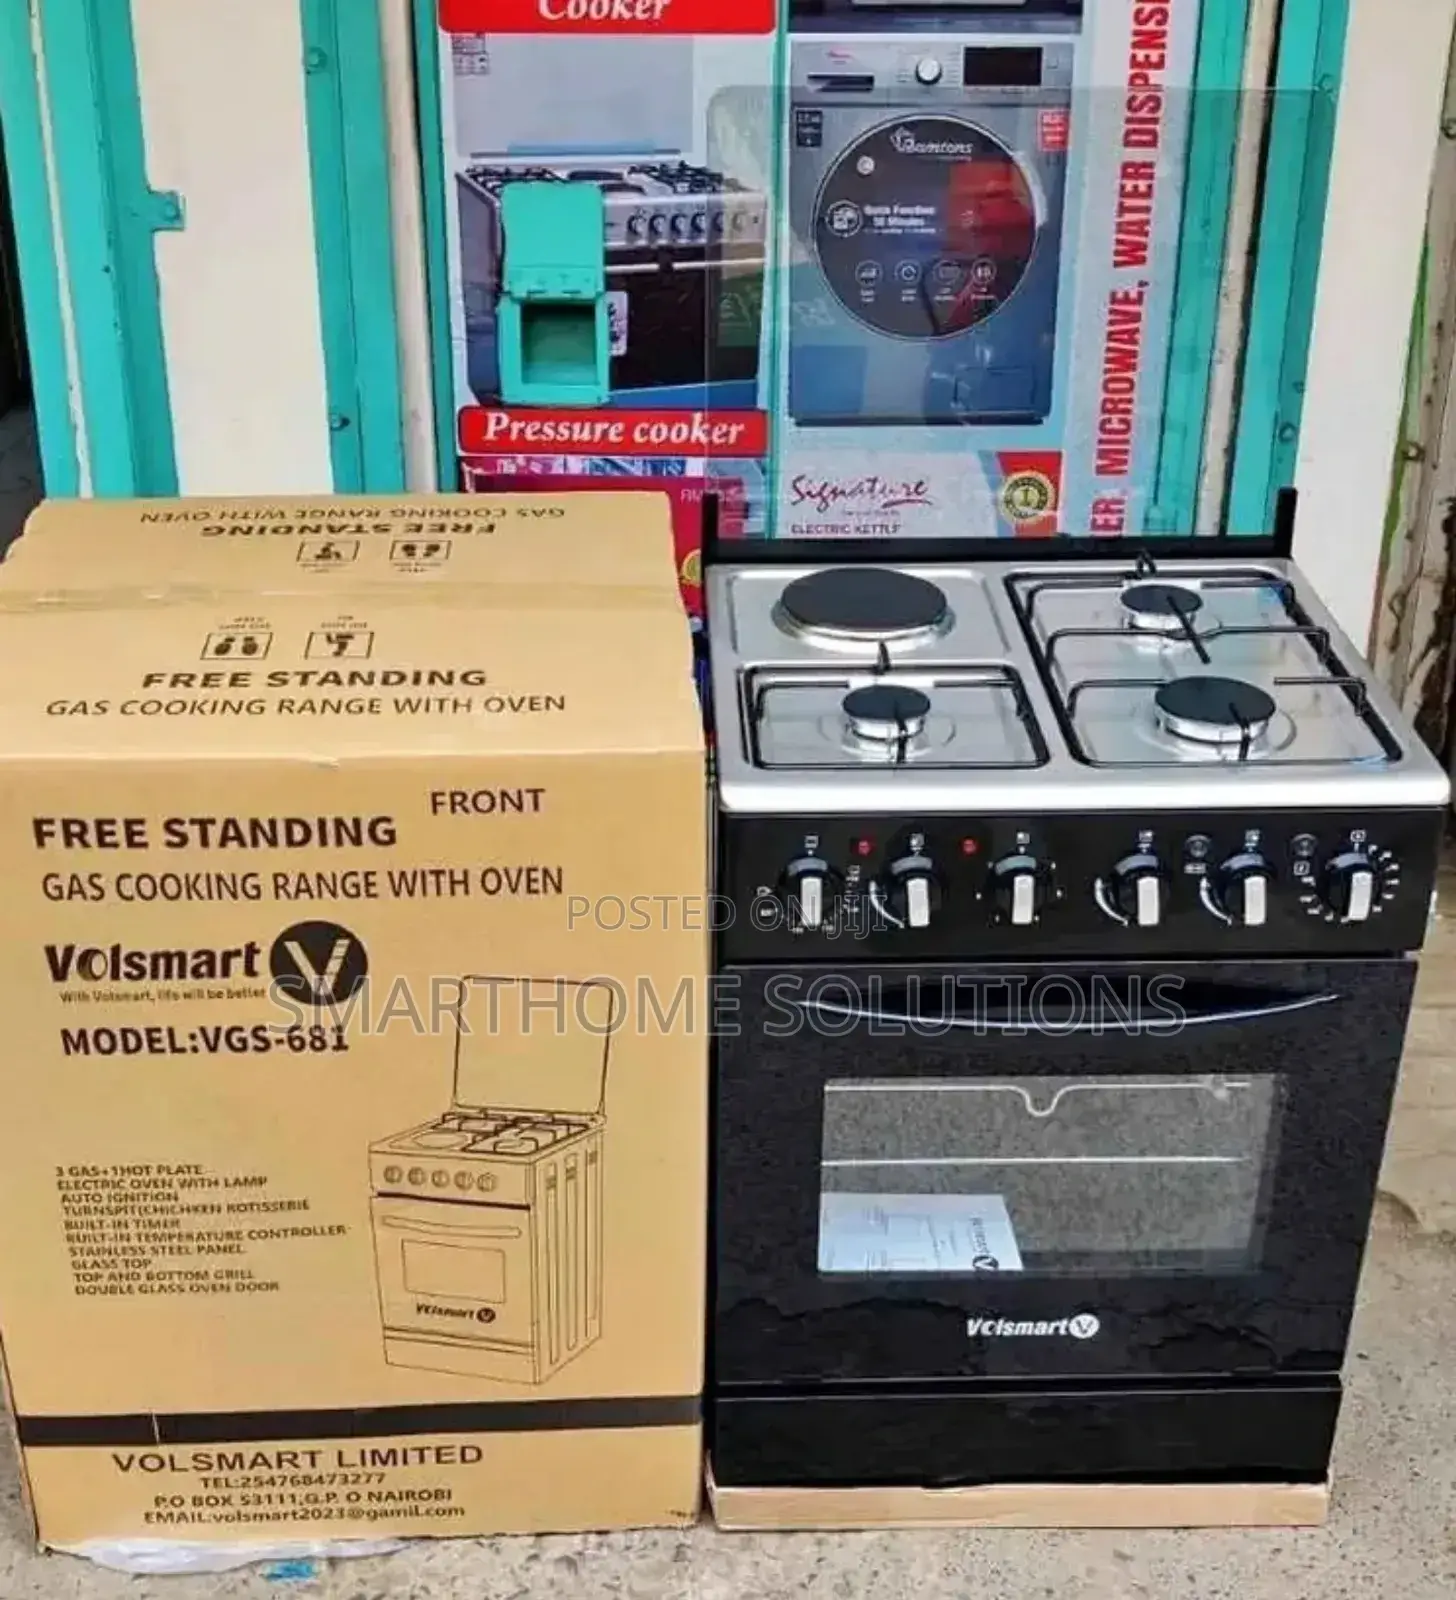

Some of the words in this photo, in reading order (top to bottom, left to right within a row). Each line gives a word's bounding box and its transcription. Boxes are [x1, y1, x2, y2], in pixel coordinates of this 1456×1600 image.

[539, 0, 672, 20] Cooker
[1123, 0, 1170, 149] DISPENS
[1113, 161, 1156, 268] WATER
[1095, 280, 1149, 475] MICROWAVE,
[483, 411, 624, 443] Pressure
[632, 411, 745, 444] cooker
[790, 475, 930, 513] Signature
[140, 511, 211, 523] OVEN
[219, 510, 286, 521] WITH
[295, 508, 381, 519] RANGE
[390, 507, 507, 519] COOKING
[516, 507, 565, 518] GAS
[202, 523, 392, 537] STANDING
[404, 522, 496, 535] FREE
[791, 524, 850, 534] ELECTRIC
[142, 670, 252, 688] FREE
[266, 669, 487, 687] STANDING
[46, 699, 110, 716] GAS
[119, 699, 266, 716] COOKING
[277, 698, 382, 715] RANGE
[393, 696, 473, 714] WITH
[483, 695, 566, 712] OVEN
[431, 788, 545, 816] FRONT
[33, 817, 149, 849] FREE
[164, 815, 398, 848] STANDING
[42, 872, 105, 902] GAS
[116, 871, 262, 902] COOKING
[273, 869, 378, 900] RANGE
[388, 868, 470, 898] WITH
[480, 867, 563, 896] OVEN
[45, 941, 262, 983] Volsmart
[60, 990, 89, 1003] With
[182, 988, 204, 1000] will
[206, 988, 224, 999] be
[226, 987, 267, 999] better
[60, 1025, 350, 1056] MODEL:VGS-681
[55, 1166, 64, 1177] 3
[157, 1164, 203, 1176] PLATE
[56, 1179, 126, 1191] ELECTRIC
[130, 1178, 173, 1190] OVEN
[177, 1177, 220, 1190] WITH
[224, 1176, 268, 1189] LAMP
[61, 1192, 103, 1205] AUTO
[107, 1190, 180, 1204] IGNITION
[226, 1199, 310, 1213] ROTISSERIE
[64, 1217, 129, 1231] BUILT-IN
[133, 1217, 181, 1230] TIMER
[65, 1231, 131, 1244] BUILT-IN
[135, 1229, 244, 1244] TEMPERATURE
[247, 1224, 347, 1240] CONTROLLER
[68, 1244, 146, 1258] STAINLESS
[150, 1243, 192, 1257] STEEL
[196, 1242, 245, 1256] PANEL
[71, 1258, 119, 1271] GLASS
[124, 1257, 152, 1270] TOP
[73, 1271, 103, 1284] TOP
[106, 1270, 141, 1283] AND
[146, 1269, 209, 1282] BOTTOM
[213, 1269, 254, 1281] GRILL
[74, 1283, 135, 1296] DOUBLE
[138, 1283, 186, 1296] GLASS
[189, 1282, 231, 1295] OVEN
[235, 1281, 279, 1294] DOOR
[966, 1316, 1068, 1337] Volsmart
[112, 1449, 323, 1473] VOLSMART
[336, 1445, 484, 1468] LIMITED
[192, 1494, 232, 1508] BOX
[367, 1488, 453, 1503] NAIROBI
